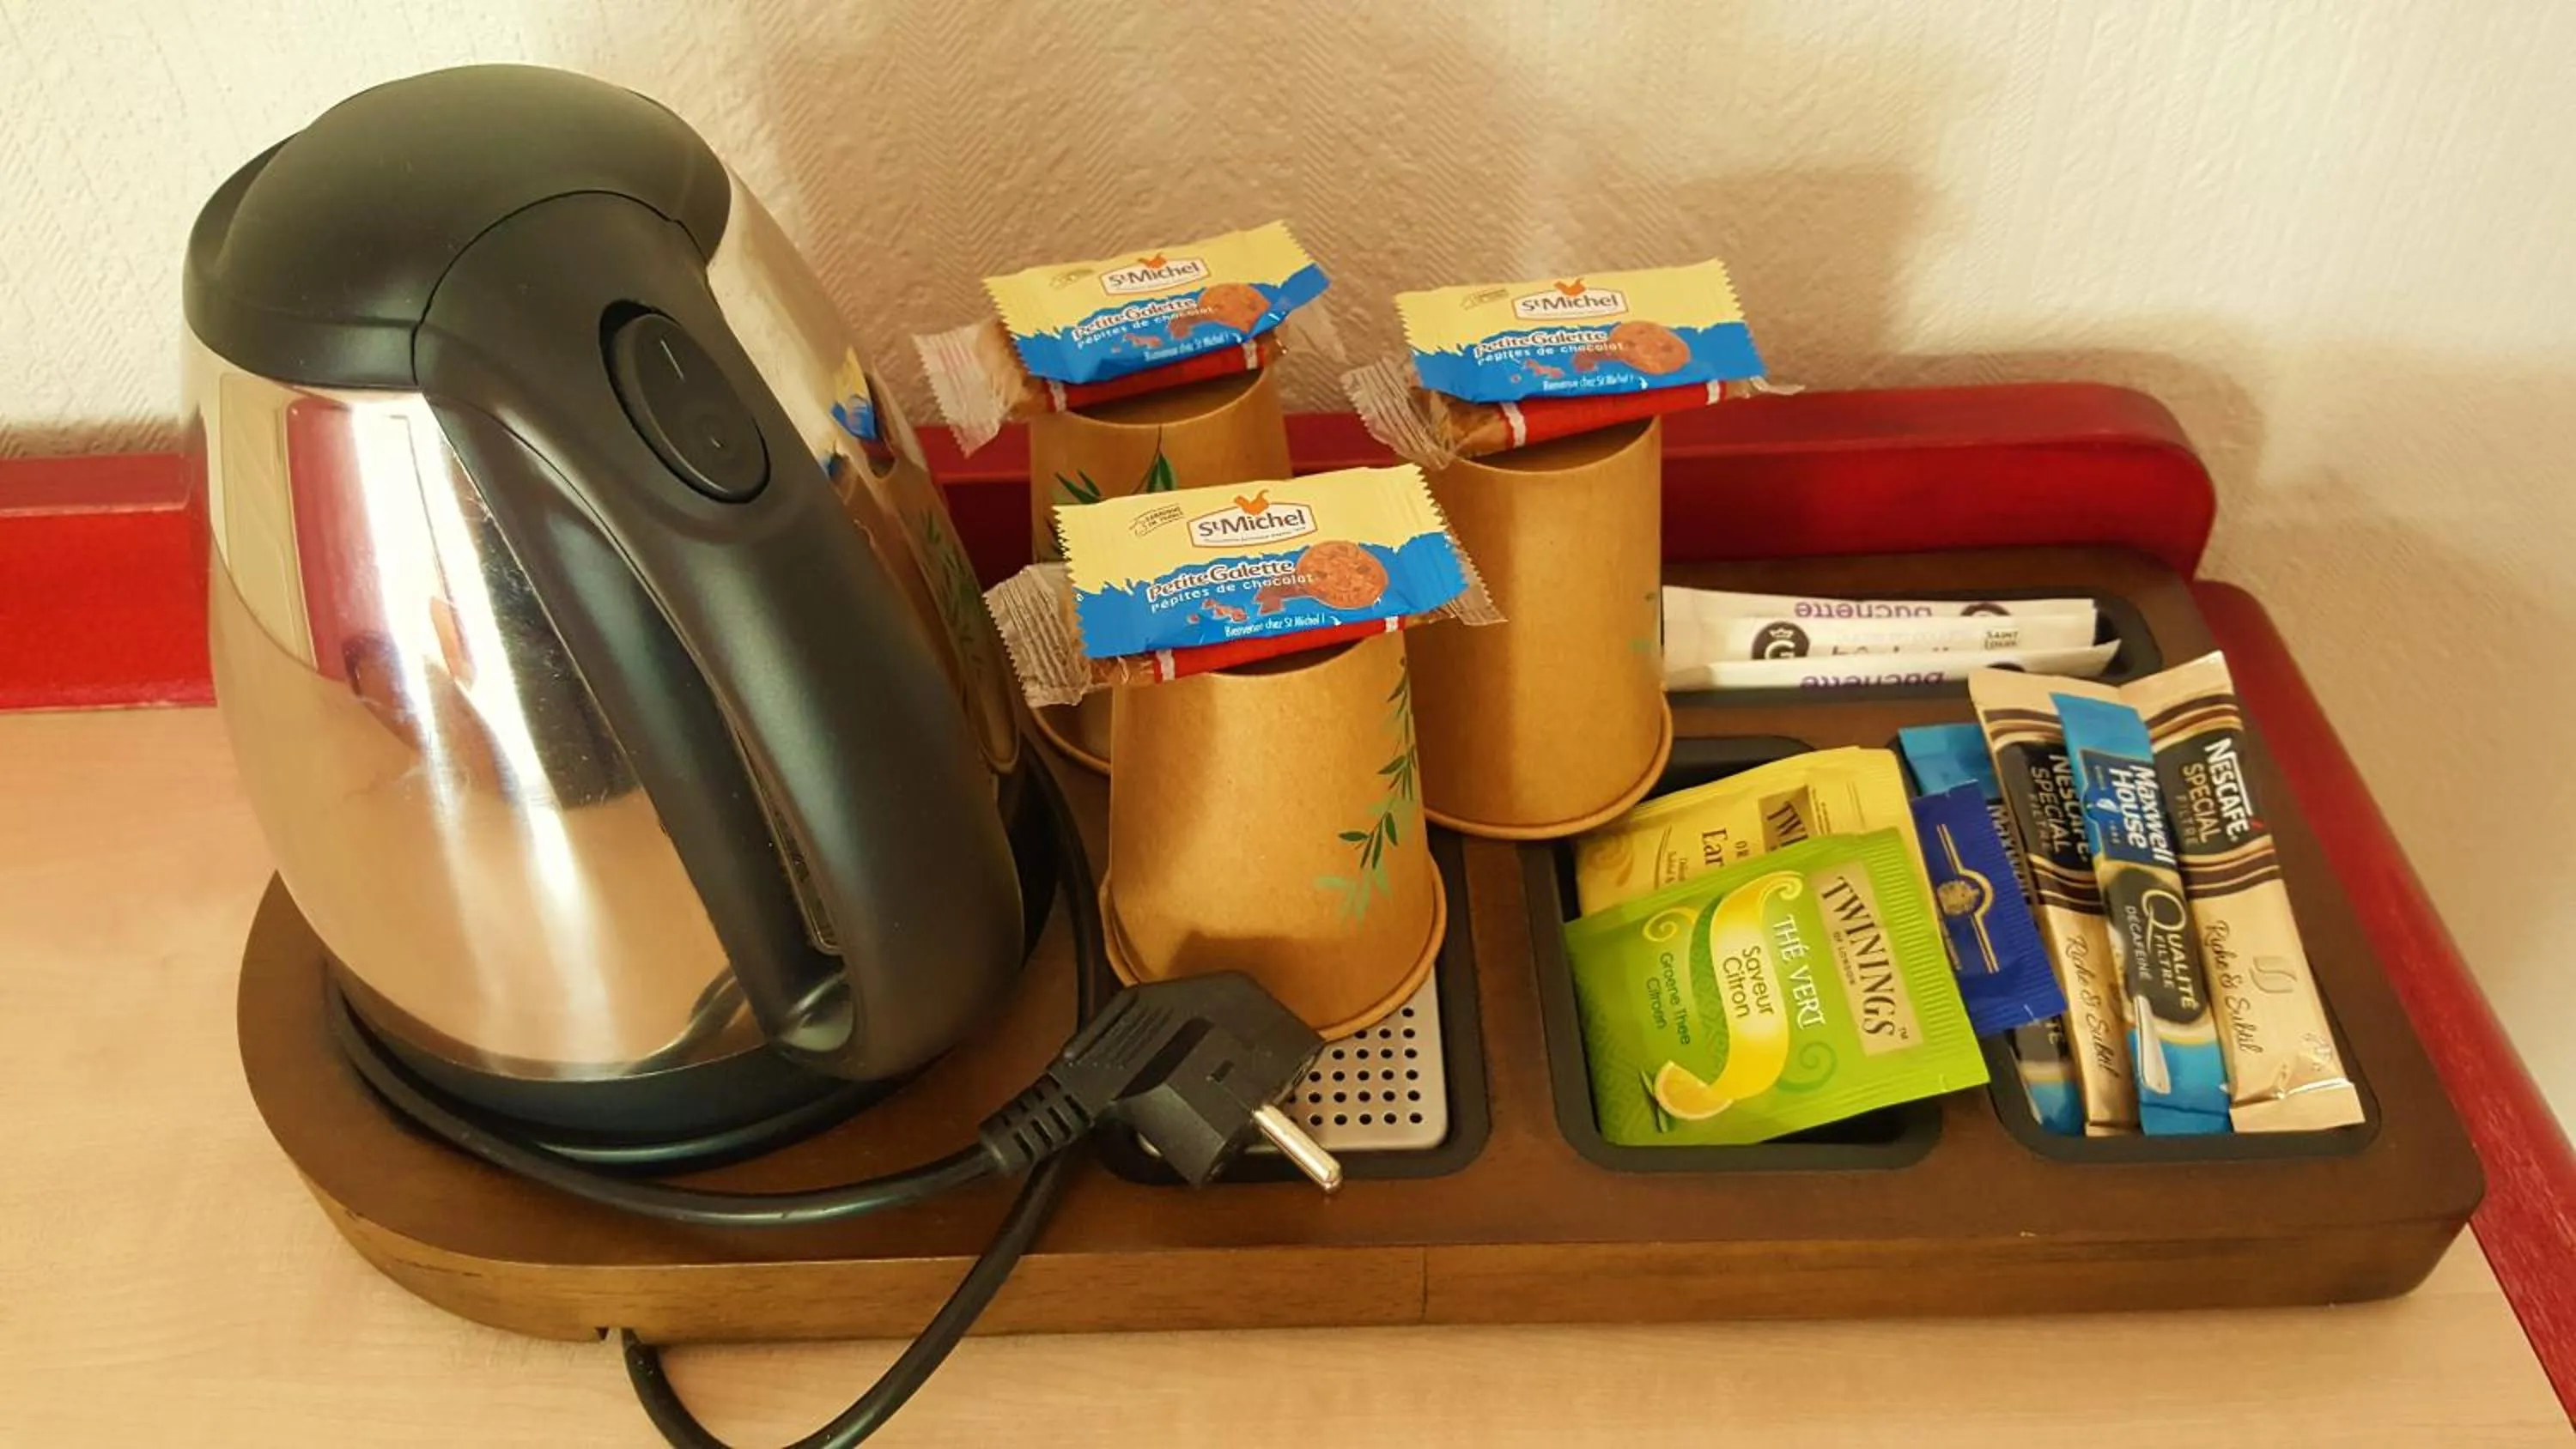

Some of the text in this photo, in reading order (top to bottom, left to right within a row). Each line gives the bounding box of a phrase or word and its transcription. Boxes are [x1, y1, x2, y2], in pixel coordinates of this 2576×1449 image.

[1536, 344, 1553, 355] de
[1217, 582, 1236, 593] de
[2031, 767, 2071, 852] SPECIAL
[2129, 765, 2176, 865] Maxwell
[2182, 762, 2221, 843] SPECIAL
[1722, 956, 1752, 1018] Citron
[1742, 945, 1774, 1016] Saveur
[1821, 876, 1896, 1036] TWININGS
[2154, 933, 2174, 989] FILTRE
[1789, 964, 1826, 1031] VERT
